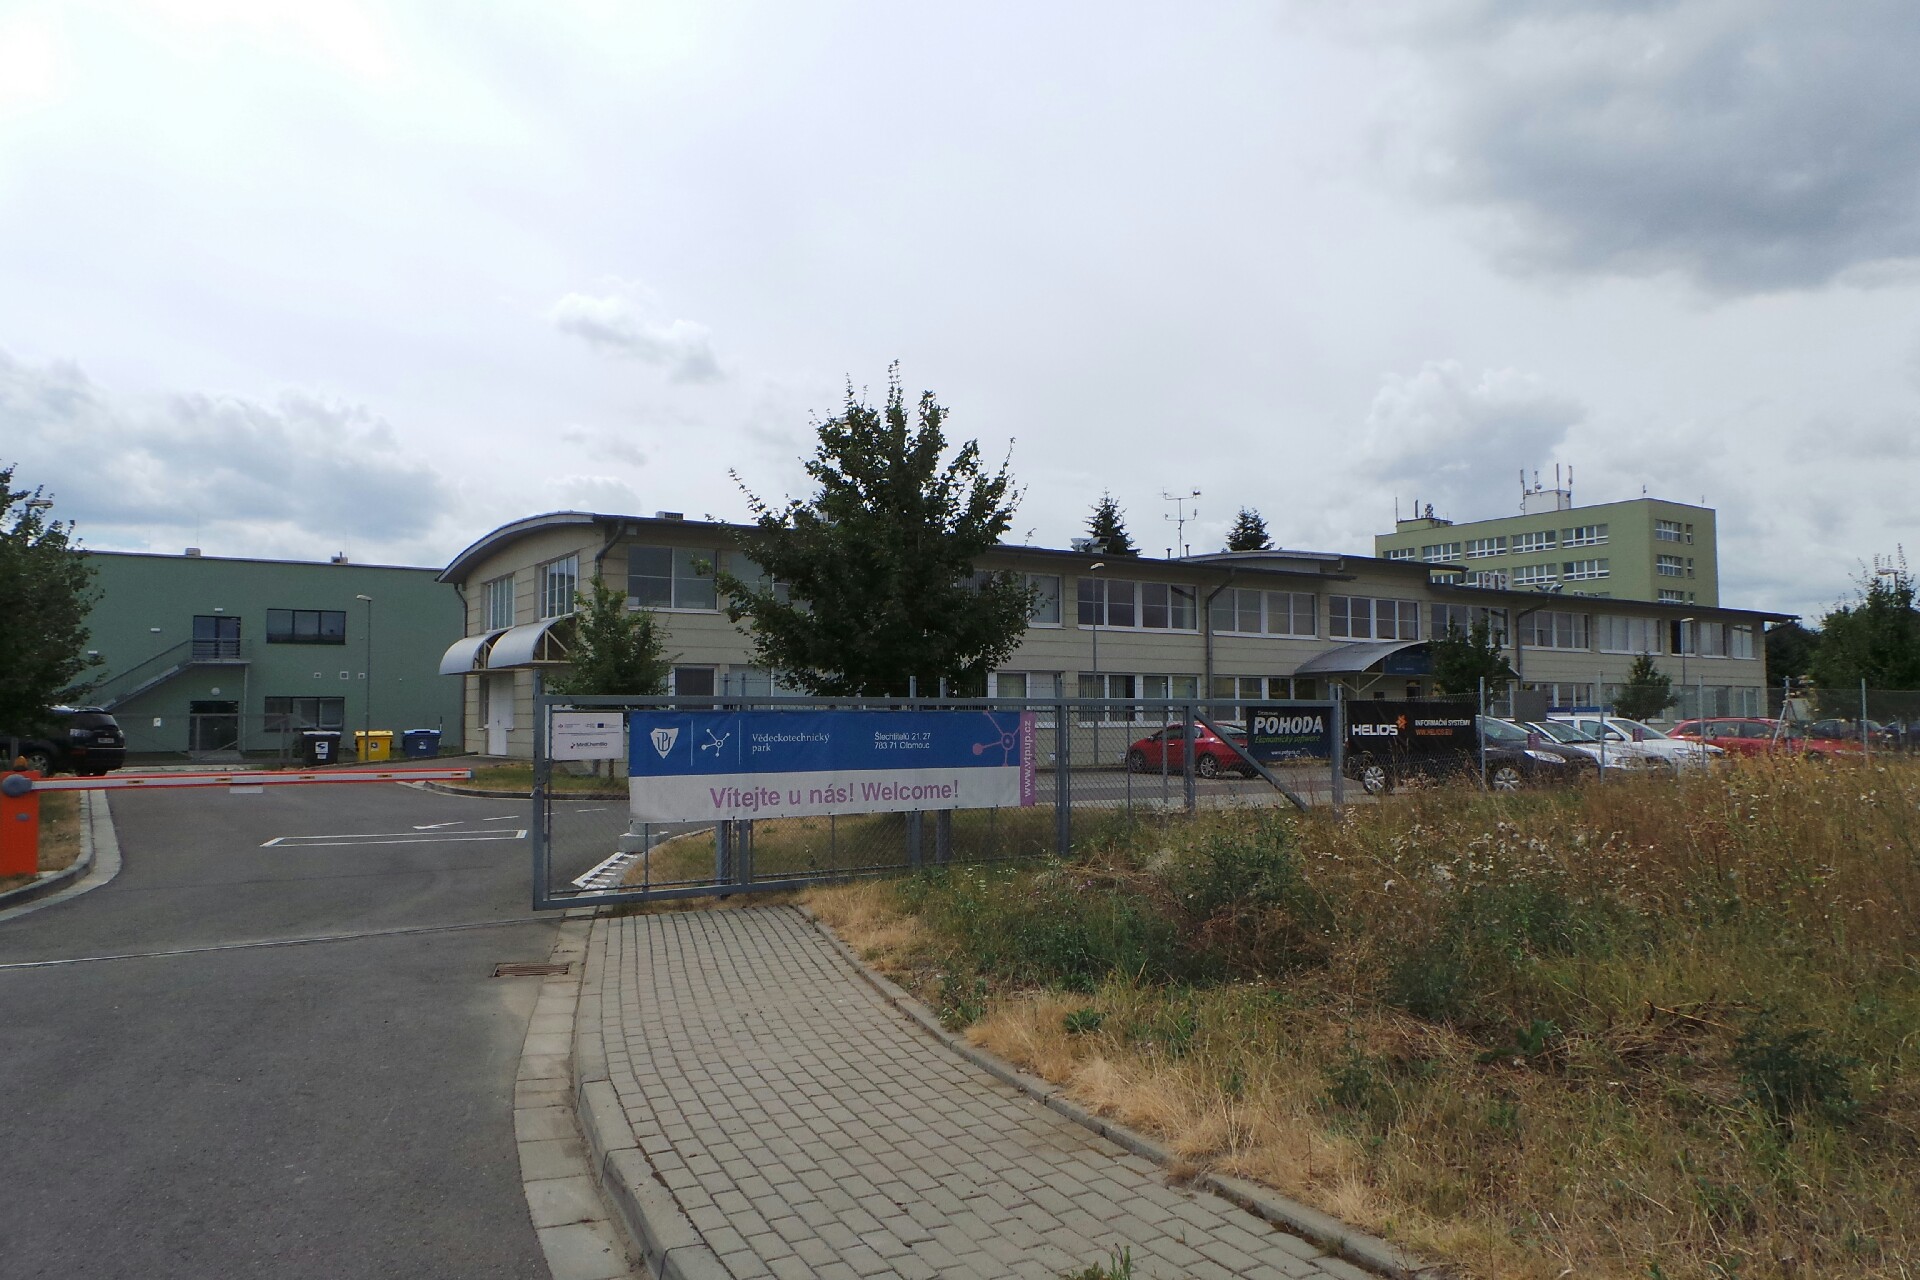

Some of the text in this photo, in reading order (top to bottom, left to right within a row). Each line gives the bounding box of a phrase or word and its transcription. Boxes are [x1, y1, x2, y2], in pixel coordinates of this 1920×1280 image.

[1253, 715, 1324, 735] POHODA
[1414, 718, 1448, 726] INFORMAČNÍ
[874, 731, 910, 741] Šlechtitelů
[1352, 724, 1399, 736] HELIOS
[752, 732, 830, 744] Vědeckotechnický
[752, 743, 771, 754] park
[874, 741, 888, 750] 783
[889, 741, 897, 749] 71
[1024, 720, 1033, 797] www.vtpup.cz
[710, 780, 959, 812] Vítejte u nás! Welcome!
